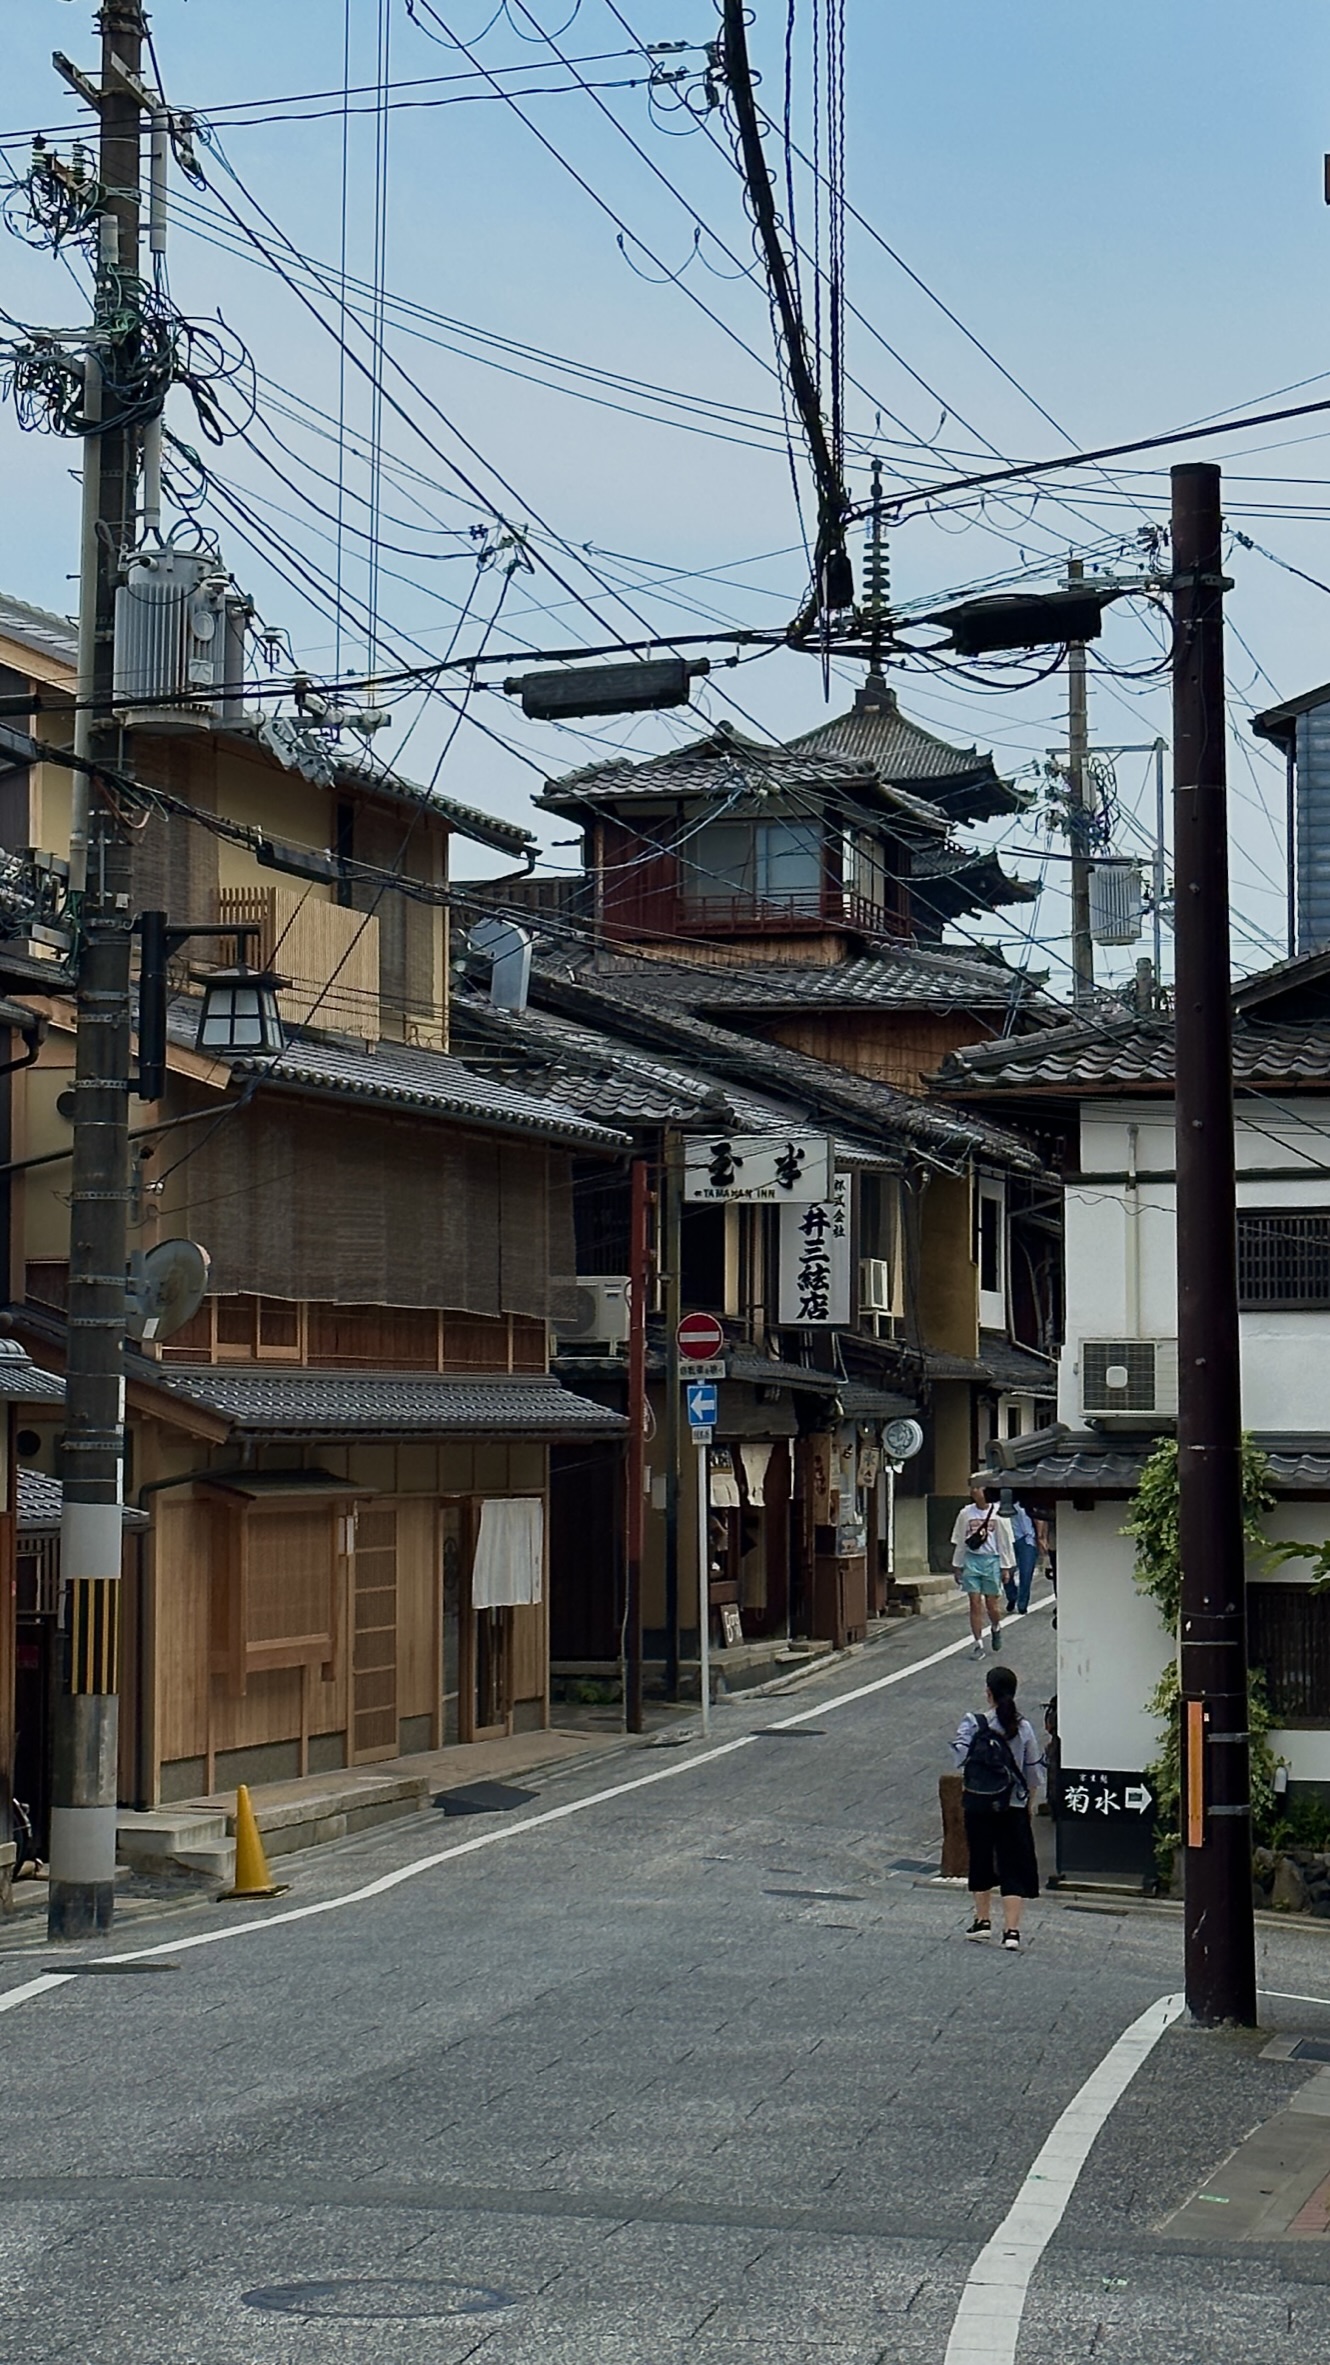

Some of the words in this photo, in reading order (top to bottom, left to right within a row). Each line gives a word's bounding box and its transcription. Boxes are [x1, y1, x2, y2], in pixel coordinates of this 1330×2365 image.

[704, 1189, 752, 1198] TAMAHAN
[757, 1189, 775, 1198] INN
[796, 1203, 831, 1320] 井三絃店
[1064, 1785, 1121, 1815] 菊水
